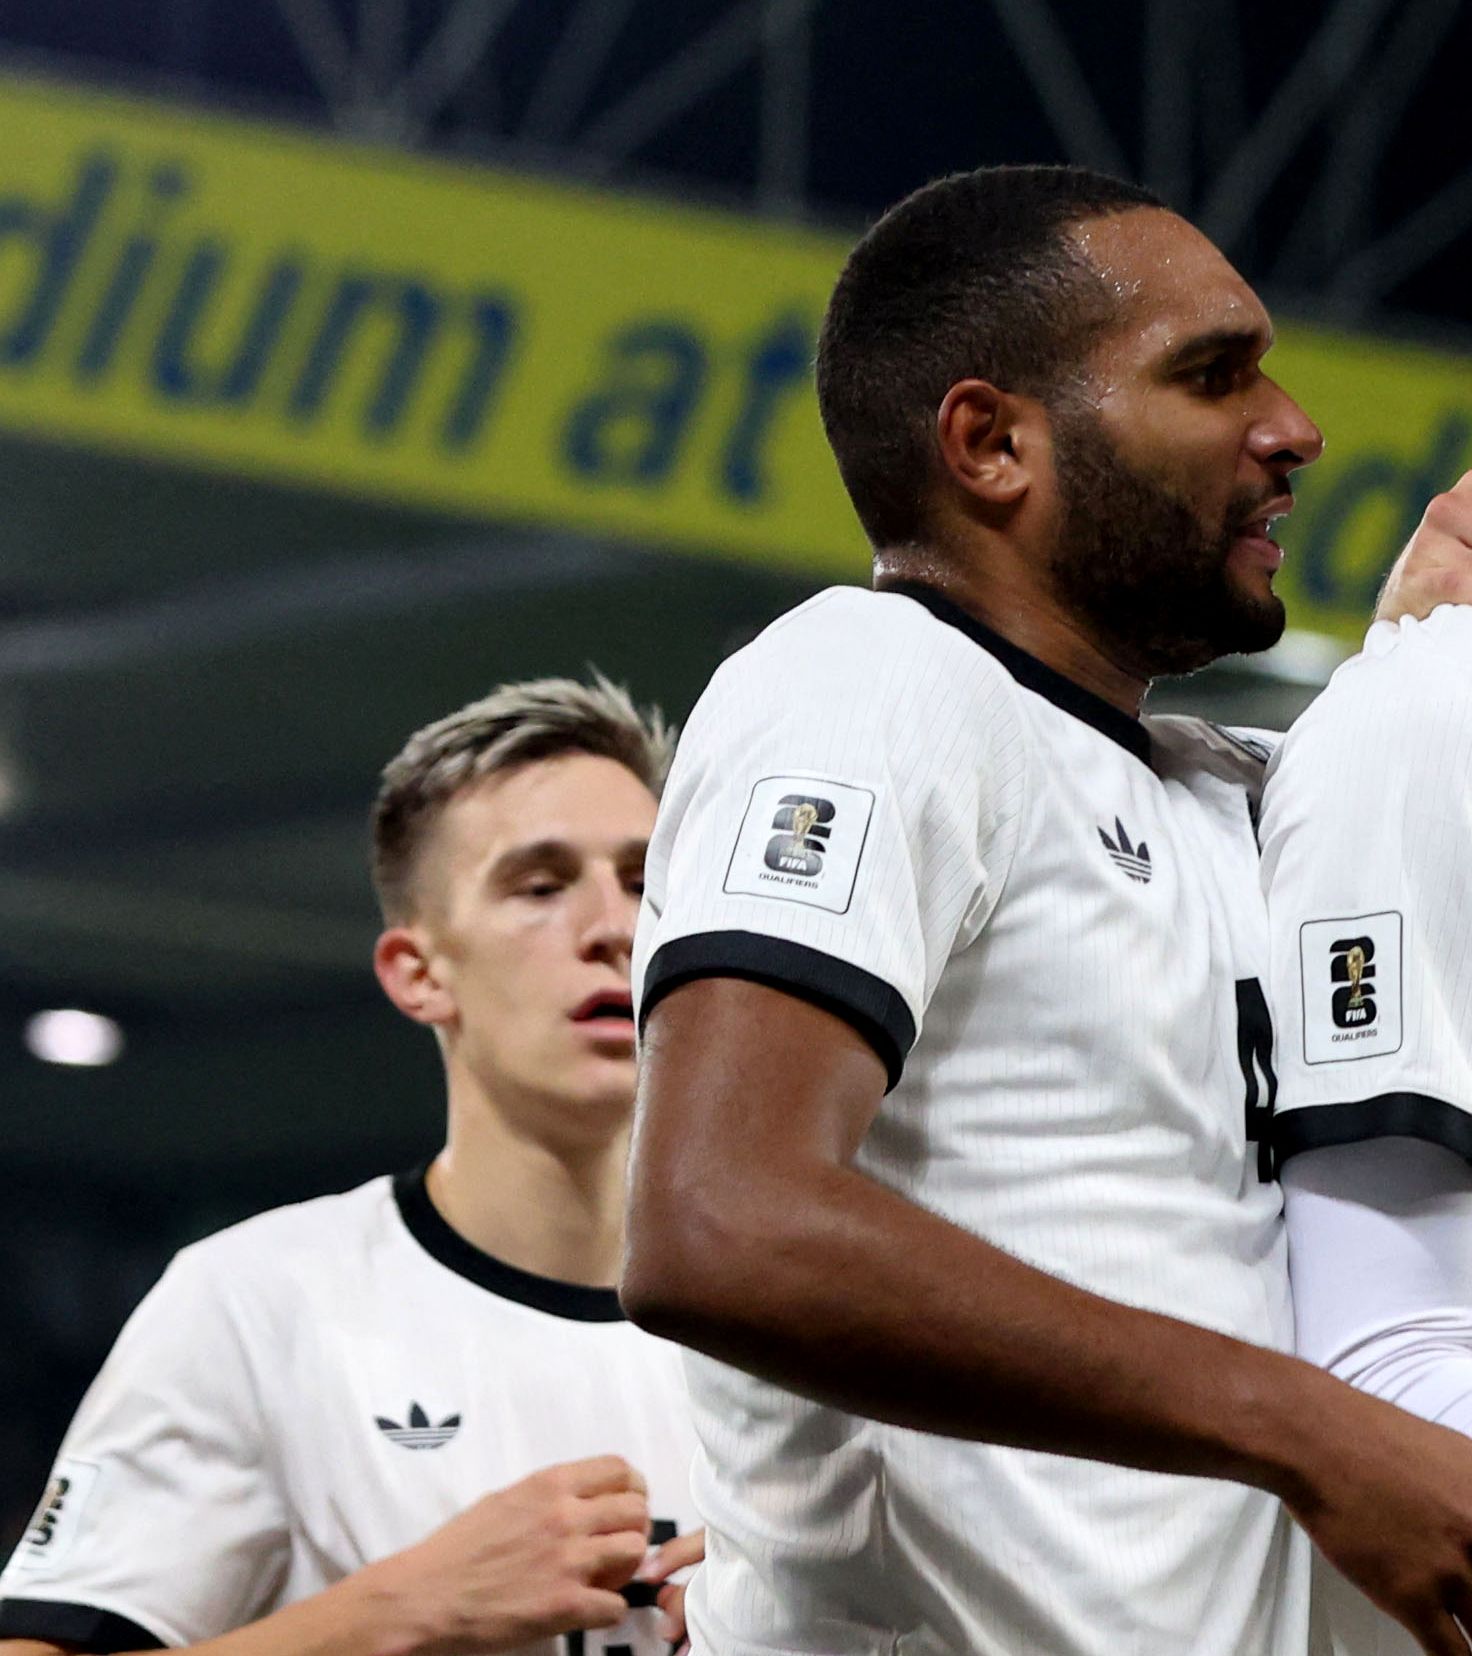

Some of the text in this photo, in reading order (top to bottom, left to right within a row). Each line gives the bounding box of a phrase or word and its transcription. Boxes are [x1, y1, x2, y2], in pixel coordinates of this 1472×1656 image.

[778, 856, 808, 872] FIFA
[758, 872, 818, 889] QUALIFIERS
[1345, 1008, 1368, 1023] FIFA
